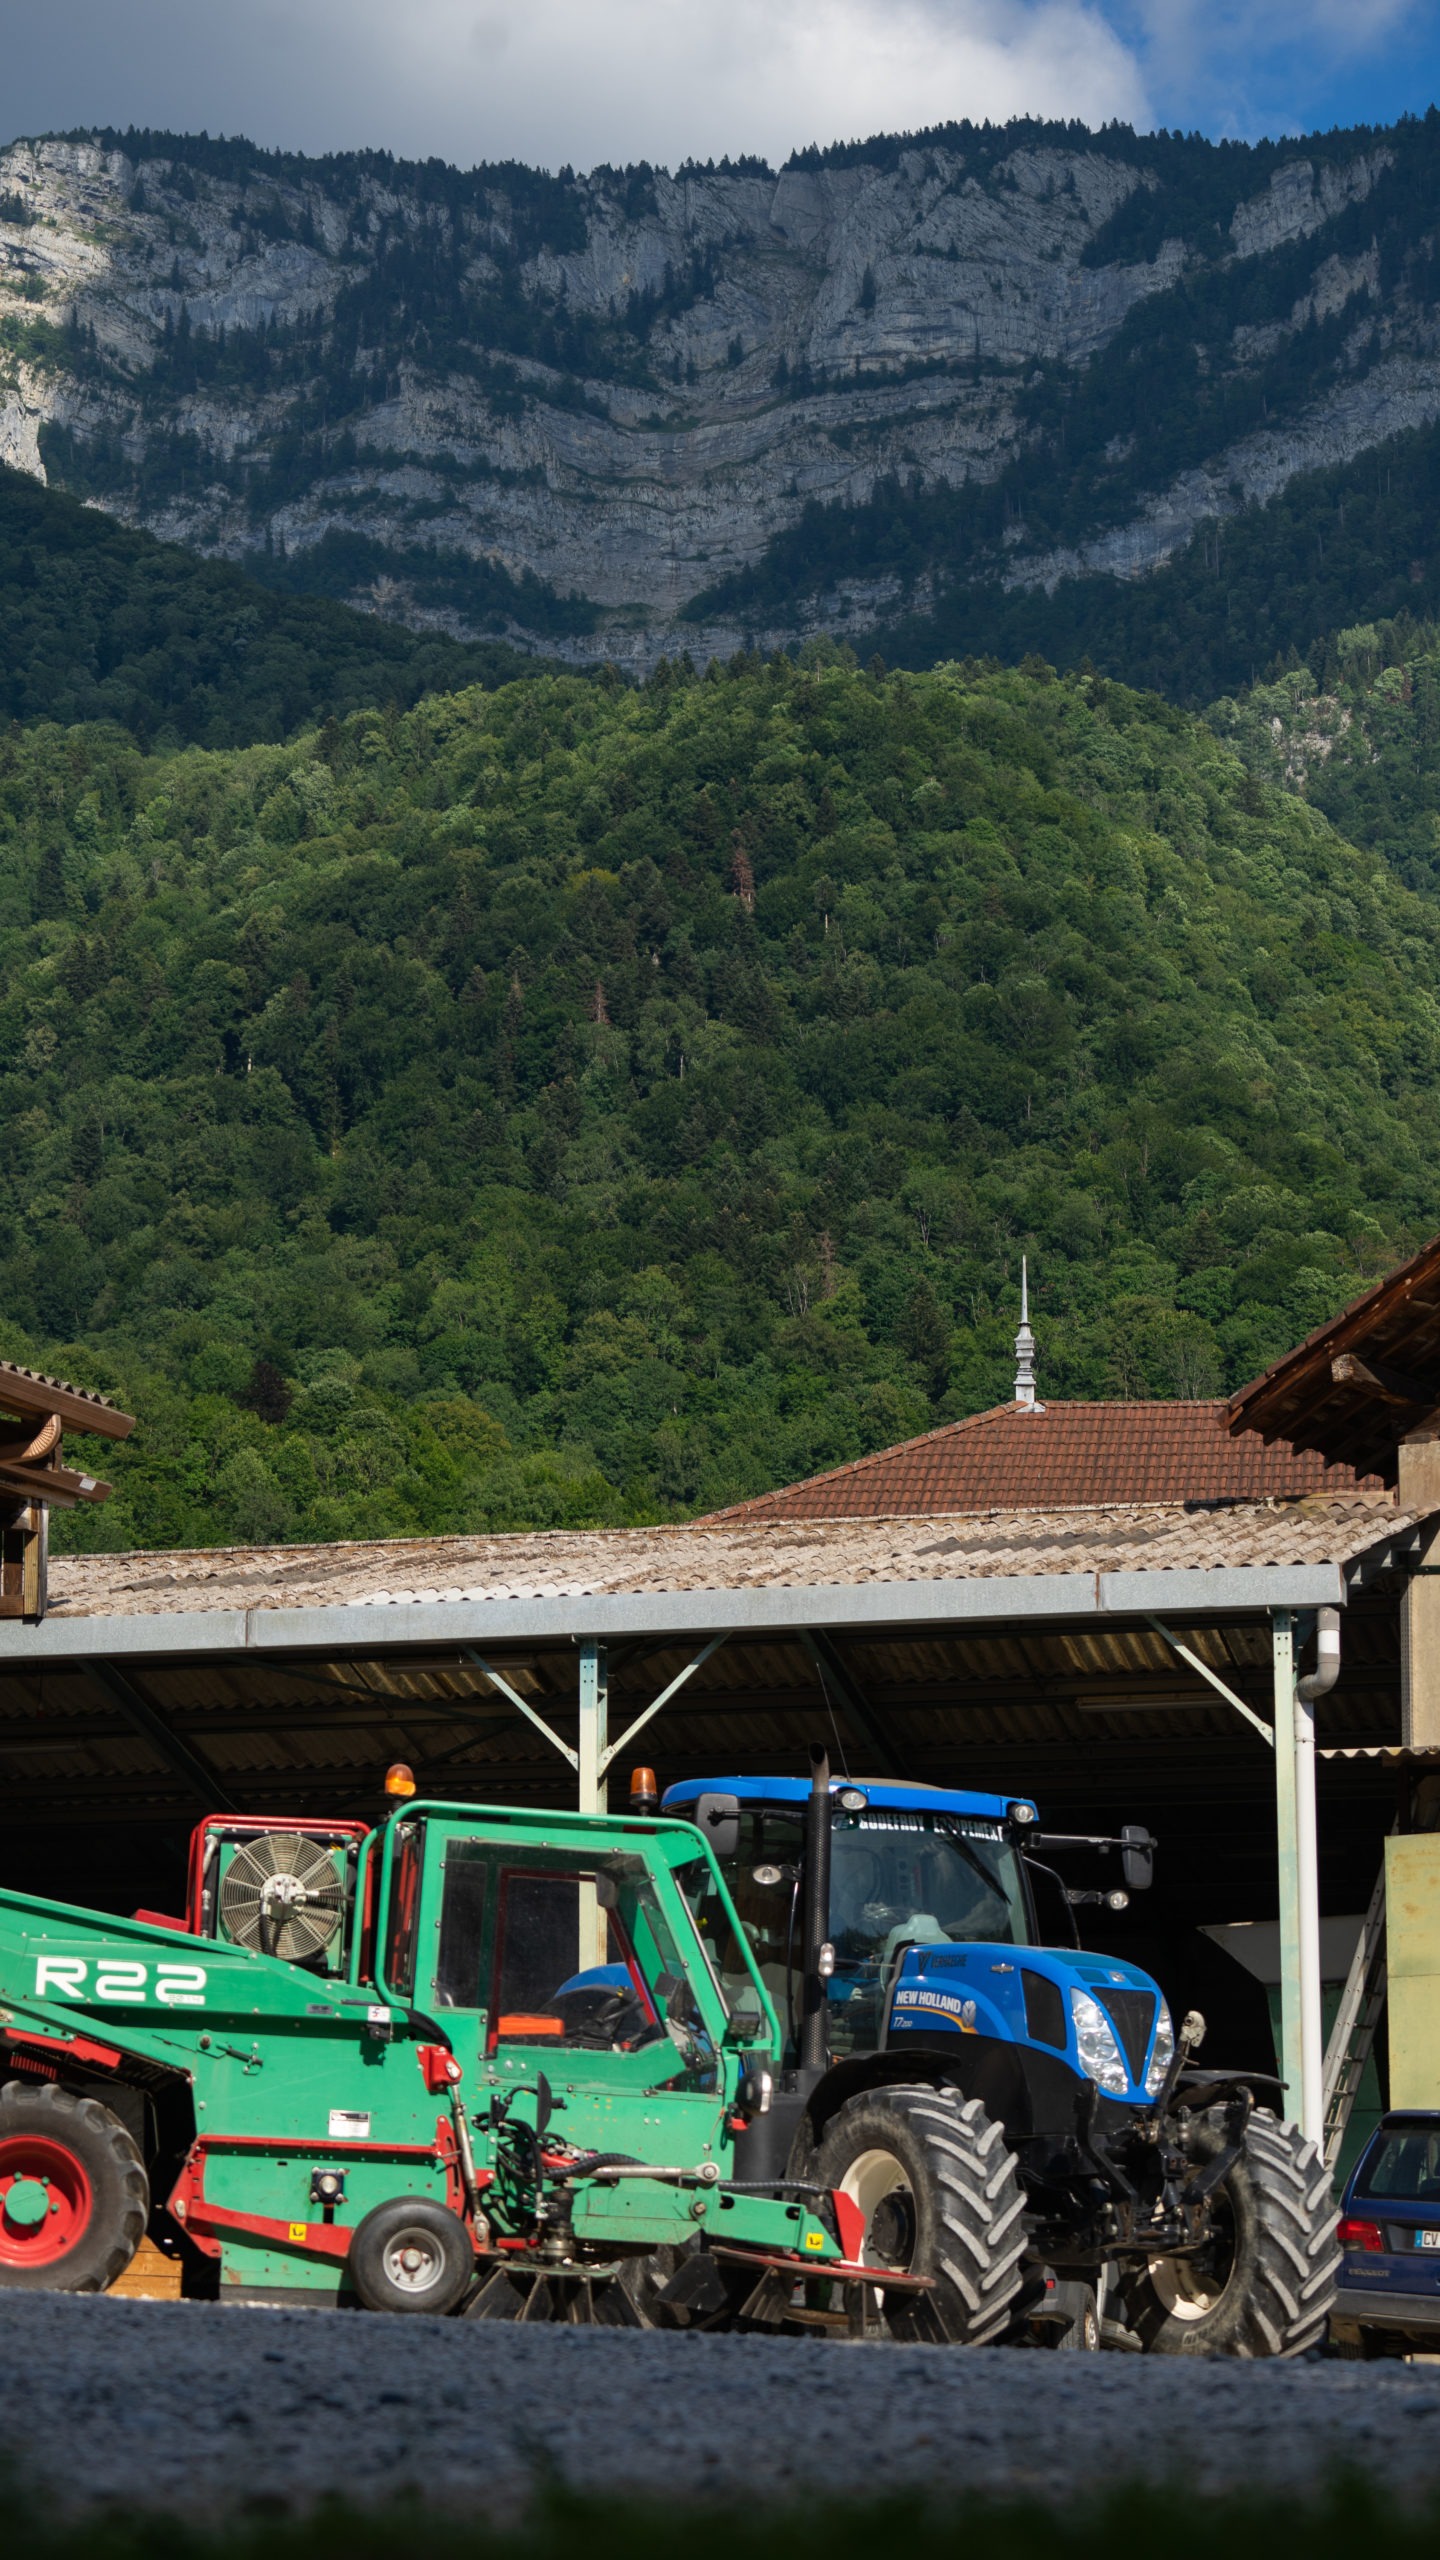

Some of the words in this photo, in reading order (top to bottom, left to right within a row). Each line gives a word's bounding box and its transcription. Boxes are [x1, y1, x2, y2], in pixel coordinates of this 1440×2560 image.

[858, 1813, 925, 1832] GODEFROY
[933, 1816, 1003, 1842] EIPEMENT
[35, 1956, 207, 2006] R22
[896, 1990, 918, 2005] NEW
[918, 1991, 961, 2014] HOLLAND
